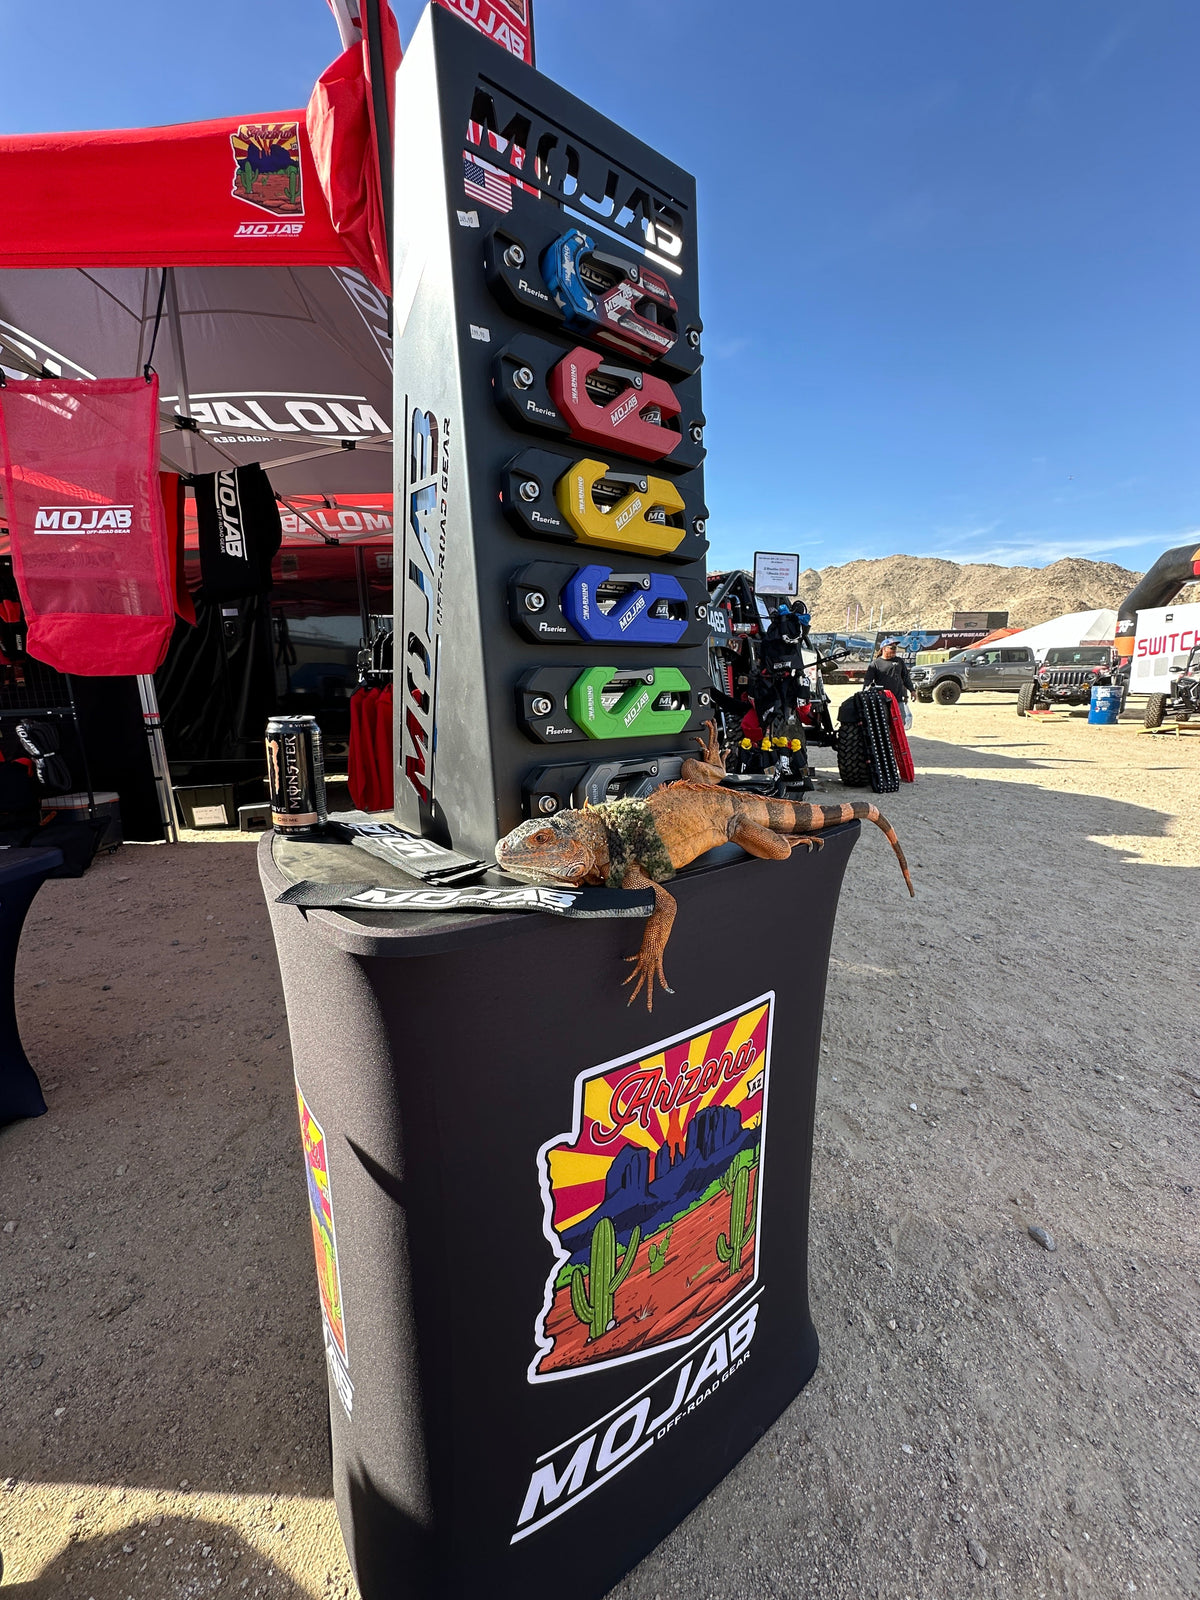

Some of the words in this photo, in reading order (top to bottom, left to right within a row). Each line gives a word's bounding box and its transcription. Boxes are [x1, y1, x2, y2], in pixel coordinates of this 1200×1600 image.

[447, 0, 525, 60] OJAB
[465, 86, 683, 257] MOJAB
[235, 224, 304, 234] MOJAB
[570, 363, 578, 400] WARNING
[610, 395, 638, 425] MOJAB
[441, 417, 451, 494] GEAR
[34, 509, 132, 529] MOJAB
[218, 470, 243, 558] MOJAB
[615, 498, 642, 530] MOJAB
[436, 498, 448, 627] OFF-ROAD
[406, 407, 439, 803] MOJAB
[581, 582, 590, 615] WARNING
[619, 597, 646, 630] MOJAB
[586, 685, 595, 717] WARNING
[623, 693, 649, 727] MOJAB
[285, 735, 302, 809] MONSTER
[352, 888, 577, 909] MOJAB
[590, 1038, 757, 1146] Arizona
[751, 1077, 762, 1092] AZ
[657, 1380, 720, 1440] OFF-ROAD
[721, 1350, 751, 1382] GEAR
[517, 1303, 759, 1526] MOJAB
